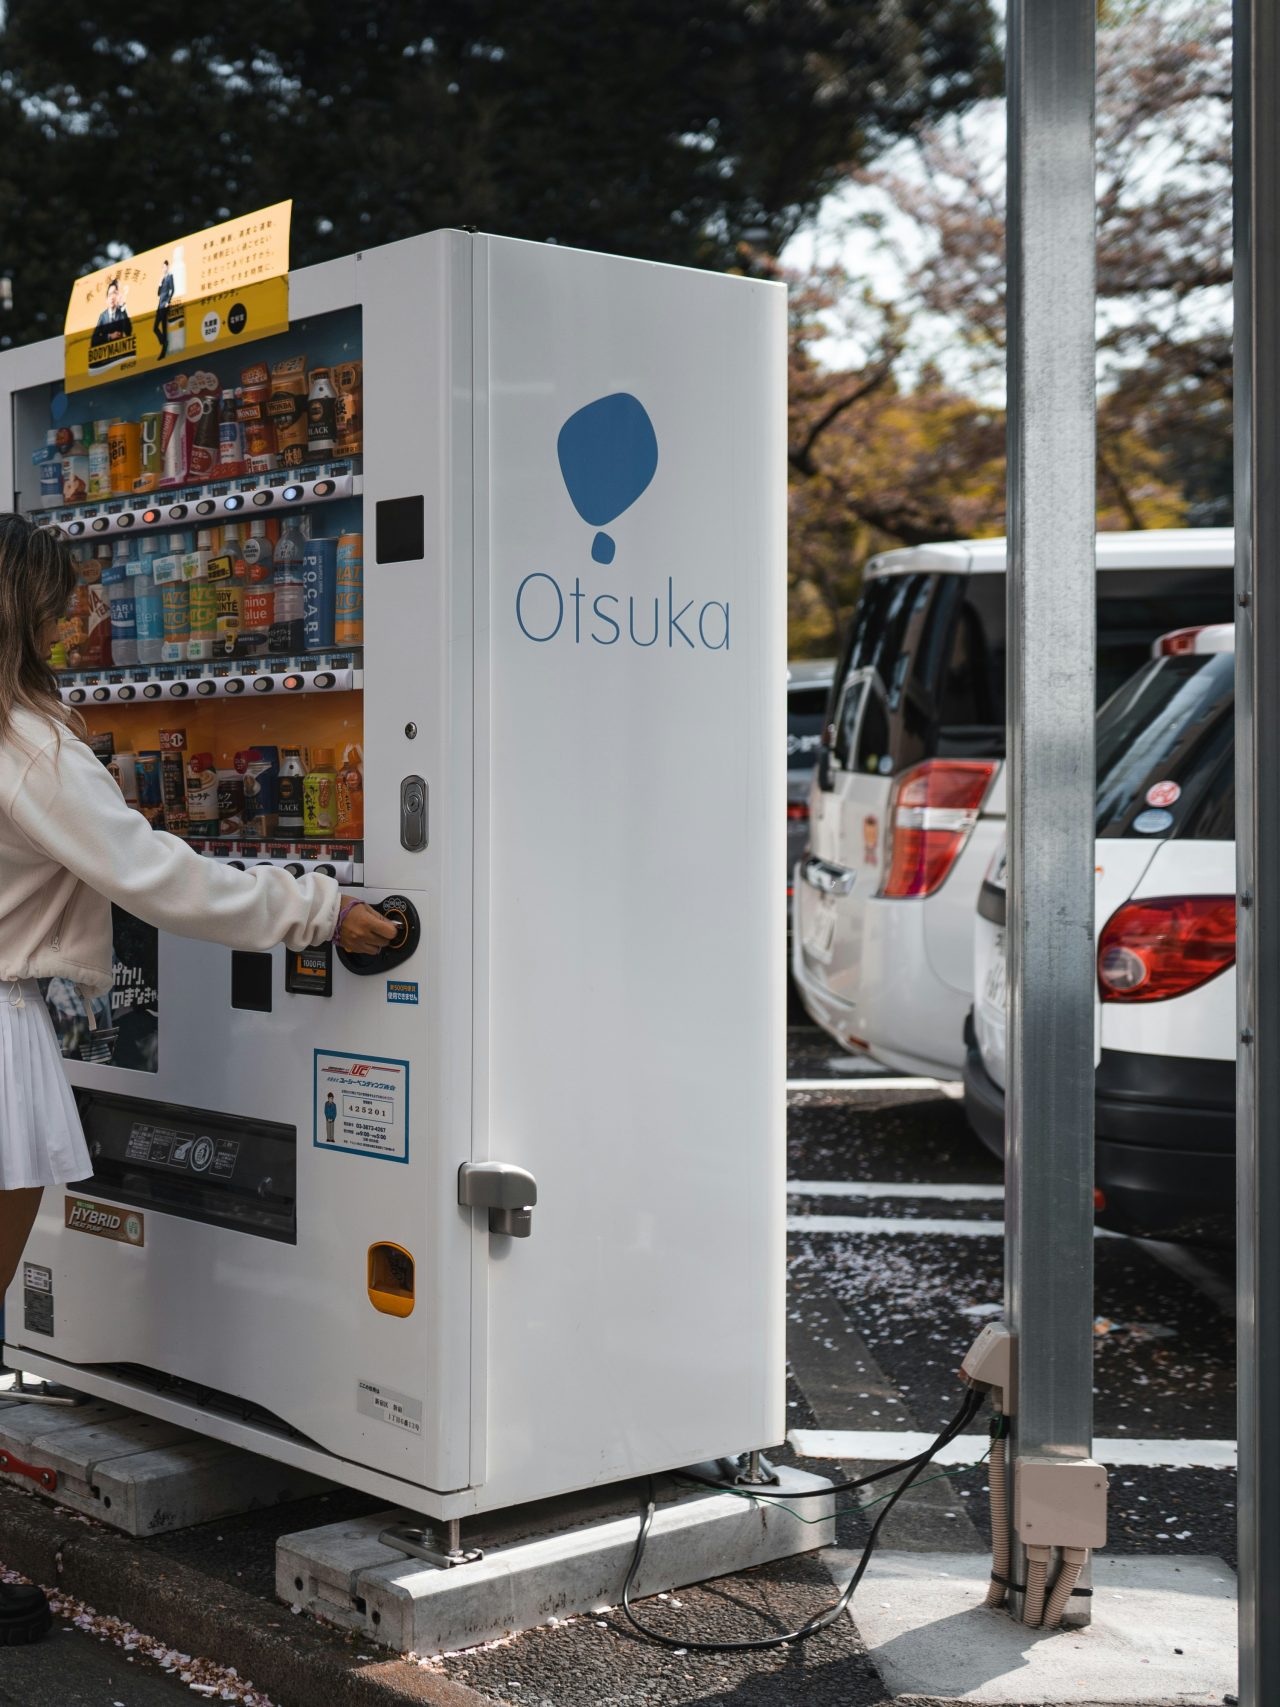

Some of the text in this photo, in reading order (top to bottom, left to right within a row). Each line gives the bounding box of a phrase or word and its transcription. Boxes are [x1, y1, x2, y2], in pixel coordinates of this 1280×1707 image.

[244, 596, 266, 608] mino
[307, 556, 320, 643] POCARI
[244, 608, 267, 619] alue
[515, 572, 730, 650] Otsuka
[387, 991, 417, 1001] 使用できません
[352, 1064, 368, 1077] UC
[348, 1104, 386, 1117] 425201
[68, 1205, 121, 1230] HYBRID
[374, 1397, 403, 1413] 新宿区 新宿
